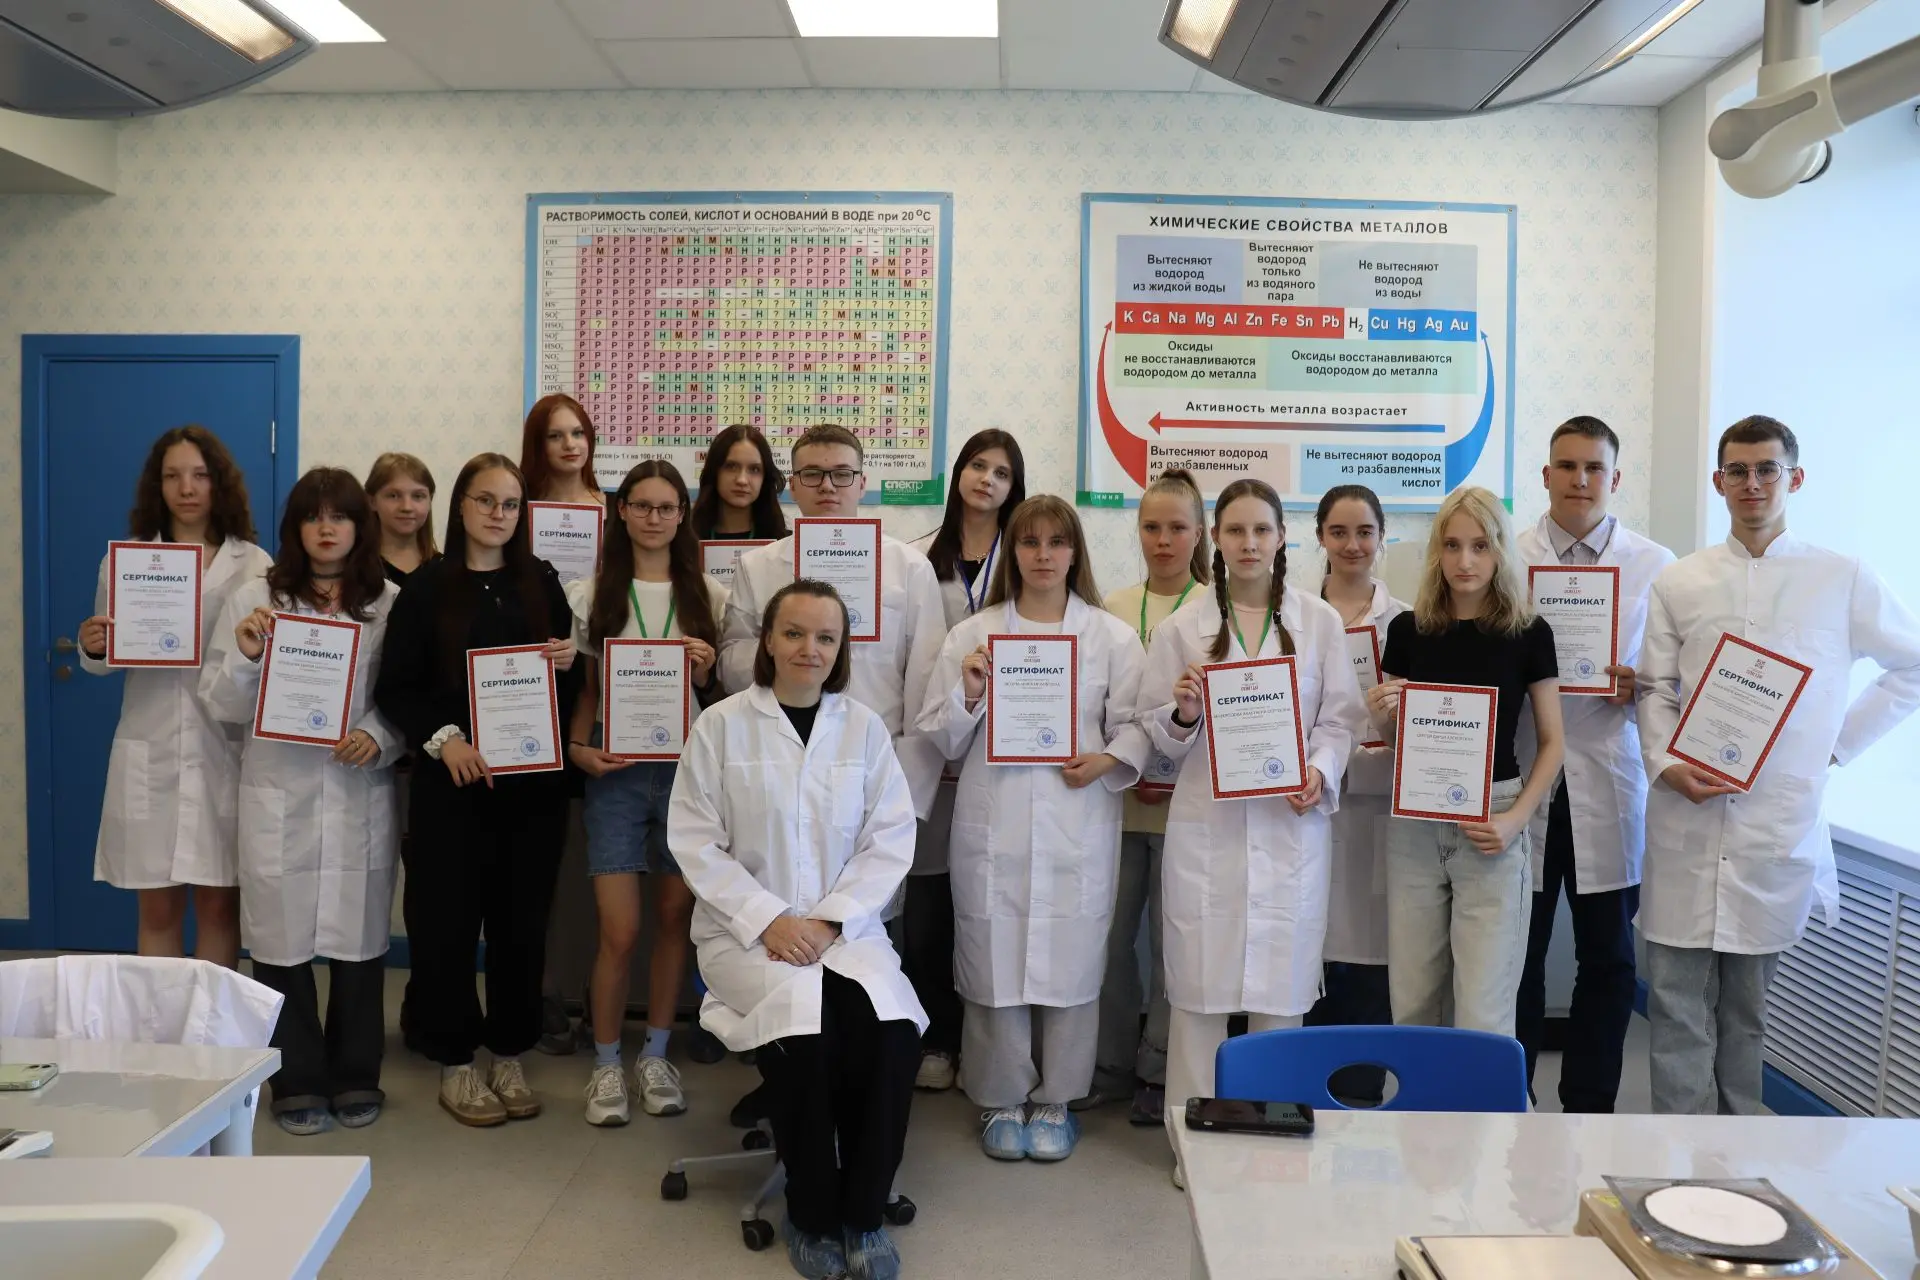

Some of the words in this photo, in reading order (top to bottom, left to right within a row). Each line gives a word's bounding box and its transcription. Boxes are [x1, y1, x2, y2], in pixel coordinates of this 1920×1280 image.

[547, 211, 646, 222] РАСТВОРИМОСТЬ
[649, 209, 690, 221] СОЛЕЙ,
[695, 210, 740, 220] КИСЛОТ
[743, 211, 750, 220] И
[754, 209, 828, 220] ОСНОВАНИЙ
[832, 211, 839, 220] В
[843, 211, 874, 222] ВОДЕ
[878, 213, 898, 223] при
[902, 211, 914, 221] 20
[1150, 216, 1260, 230] ХИМИЧЕСКИЕ
[1267, 218, 1353, 232] СВОЙСТВА
[1360, 222, 1447, 234] МЕТАЛЛОВ
[1249, 242, 1313, 252] Вытесняют
[1147, 254, 1212, 265] Вытесняют
[1258, 256, 1306, 266] водород
[1359, 260, 1373, 270] Не
[1377, 263, 1439, 271] вытесняют
[1155, 270, 1204, 280] водород
[1262, 268, 1301, 276] только
[1263, 280, 1315, 290] водяного
[1375, 276, 1423, 287] водород
[1133, 283, 1145, 291] из
[1149, 282, 1191, 293] жидкой
[1195, 284, 1225, 293] воды
[1268, 293, 1294, 303] пара
[1376, 289, 1387, 297] из
[1391, 290, 1421, 299] воды
[1124, 311, 1133, 322] K
[1143, 311, 1159, 323] Ca
[1169, 311, 1186, 324] Na
[1196, 312, 1214, 327] Mg
[1224, 313, 1237, 324] Al
[1246, 313, 1262, 325] Zn
[1272, 314, 1287, 326] Fe
[1296, 314, 1313, 327] Sn
[1322, 315, 1339, 327] Pb
[1371, 316, 1388, 329] Cu
[1398, 317, 1415, 332] Hg
[1425, 317, 1442, 332] Ag
[1450, 318, 1468, 331] Au
[1168, 341, 1213, 352] Оксиды
[1141, 356, 1255, 365] восстанавливаются
[1292, 350, 1335, 362] Оксиды
[1339, 354, 1452, 363] восстанавливаются
[1124, 369, 1187, 379] водородом
[1191, 370, 1205, 379] до
[1209, 371, 1256, 379] металла
[1306, 366, 1370, 377] водородом
[1372, 368, 1387, 377] до
[1391, 368, 1437, 376] металла
[1186, 401, 1265, 413] Активность
[1271, 406, 1326, 414] металла
[1332, 407, 1407, 418] возрастает
[1151, 445, 1215, 456] Вытесняют
[1219, 449, 1268, 460] водород
[1307, 449, 1321, 459] Не
[1325, 452, 1388, 460] вытесняют
[1392, 453, 1441, 463] водород
[1151, 461, 1163, 469] из
[1358, 464, 1440, 476] разбавленных
[539, 531, 592, 539] СЕРТИФИКАТ
[123, 574, 188, 582] СЕРТИФИКАТ
[279, 646, 344, 660] СЕРТИФИКАТ
[481, 677, 541, 688] СЕРТИФИКАТ
[1719, 668, 1783, 700] СЕРТИФИКАТ
[1217, 692, 1284, 705] СЕРТИФИКАТ
[1412, 718, 1480, 729] СЕРТИФИКАТ
